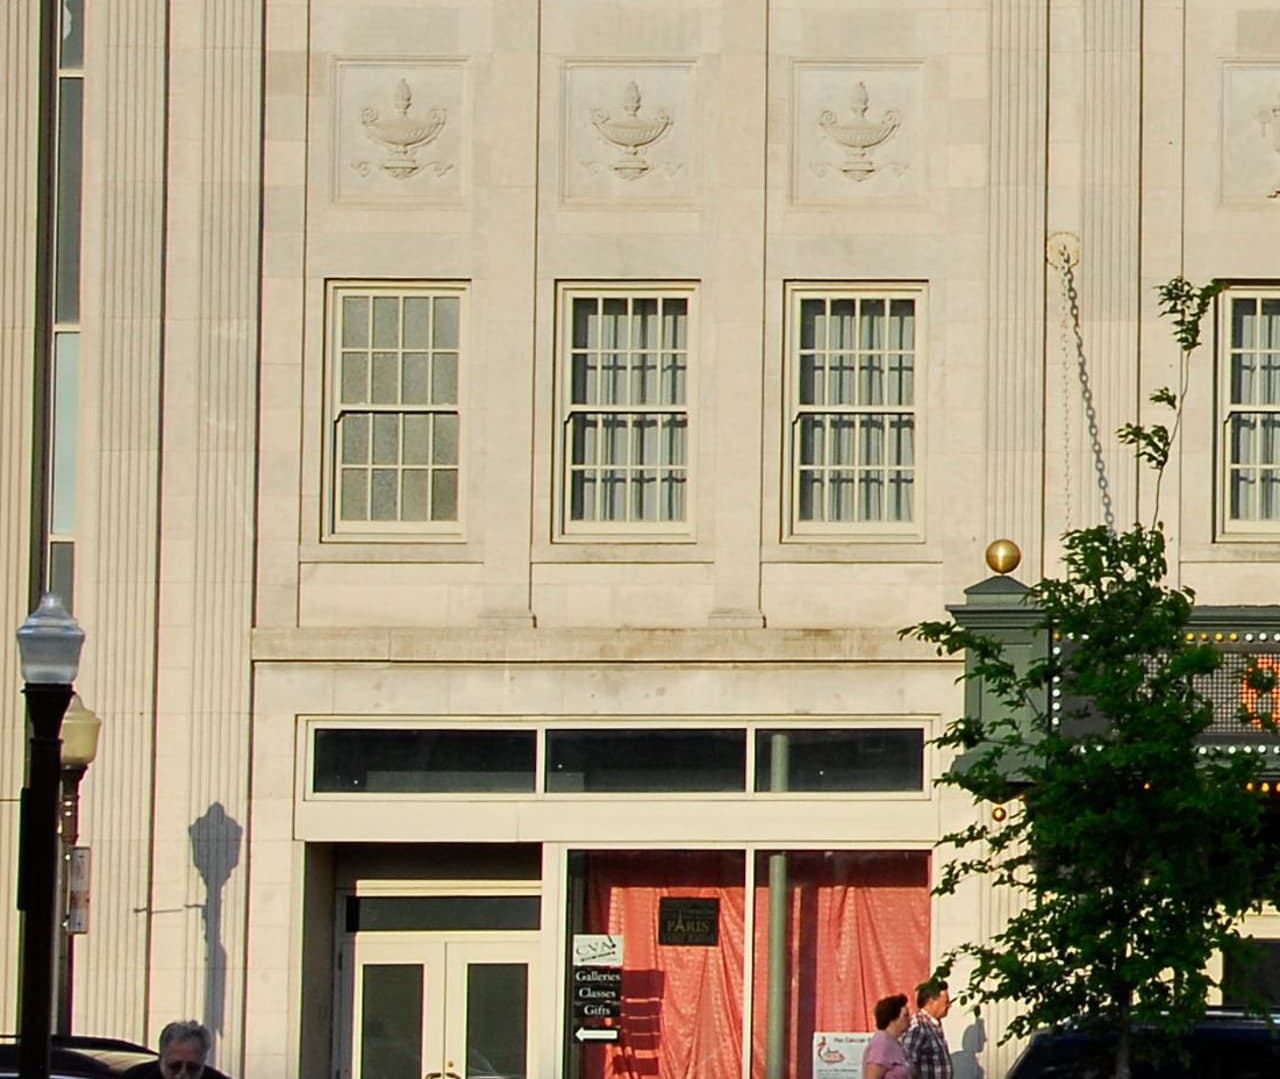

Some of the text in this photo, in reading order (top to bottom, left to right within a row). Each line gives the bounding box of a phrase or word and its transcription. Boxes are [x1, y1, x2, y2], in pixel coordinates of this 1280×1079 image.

[575, 970, 621, 982] Galleries
[578, 987, 617, 998] Classes
[583, 1004, 611, 1016] Gifts
